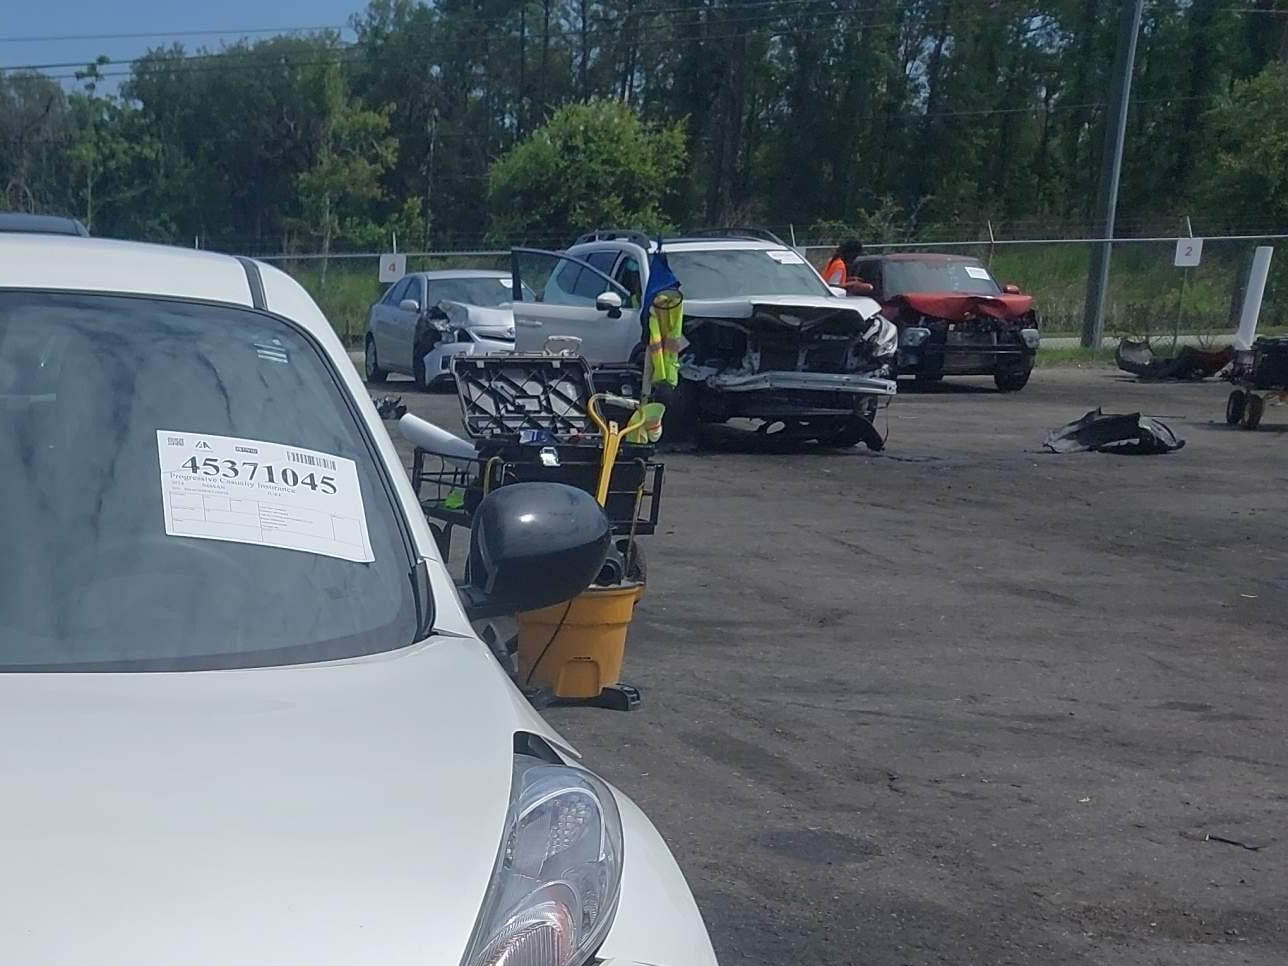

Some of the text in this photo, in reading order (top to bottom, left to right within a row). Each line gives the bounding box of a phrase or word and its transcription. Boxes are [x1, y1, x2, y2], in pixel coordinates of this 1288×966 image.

[1184, 246, 1193, 257] 2
[388, 263, 396, 273] 4
[181, 455, 338, 495] 45371045
